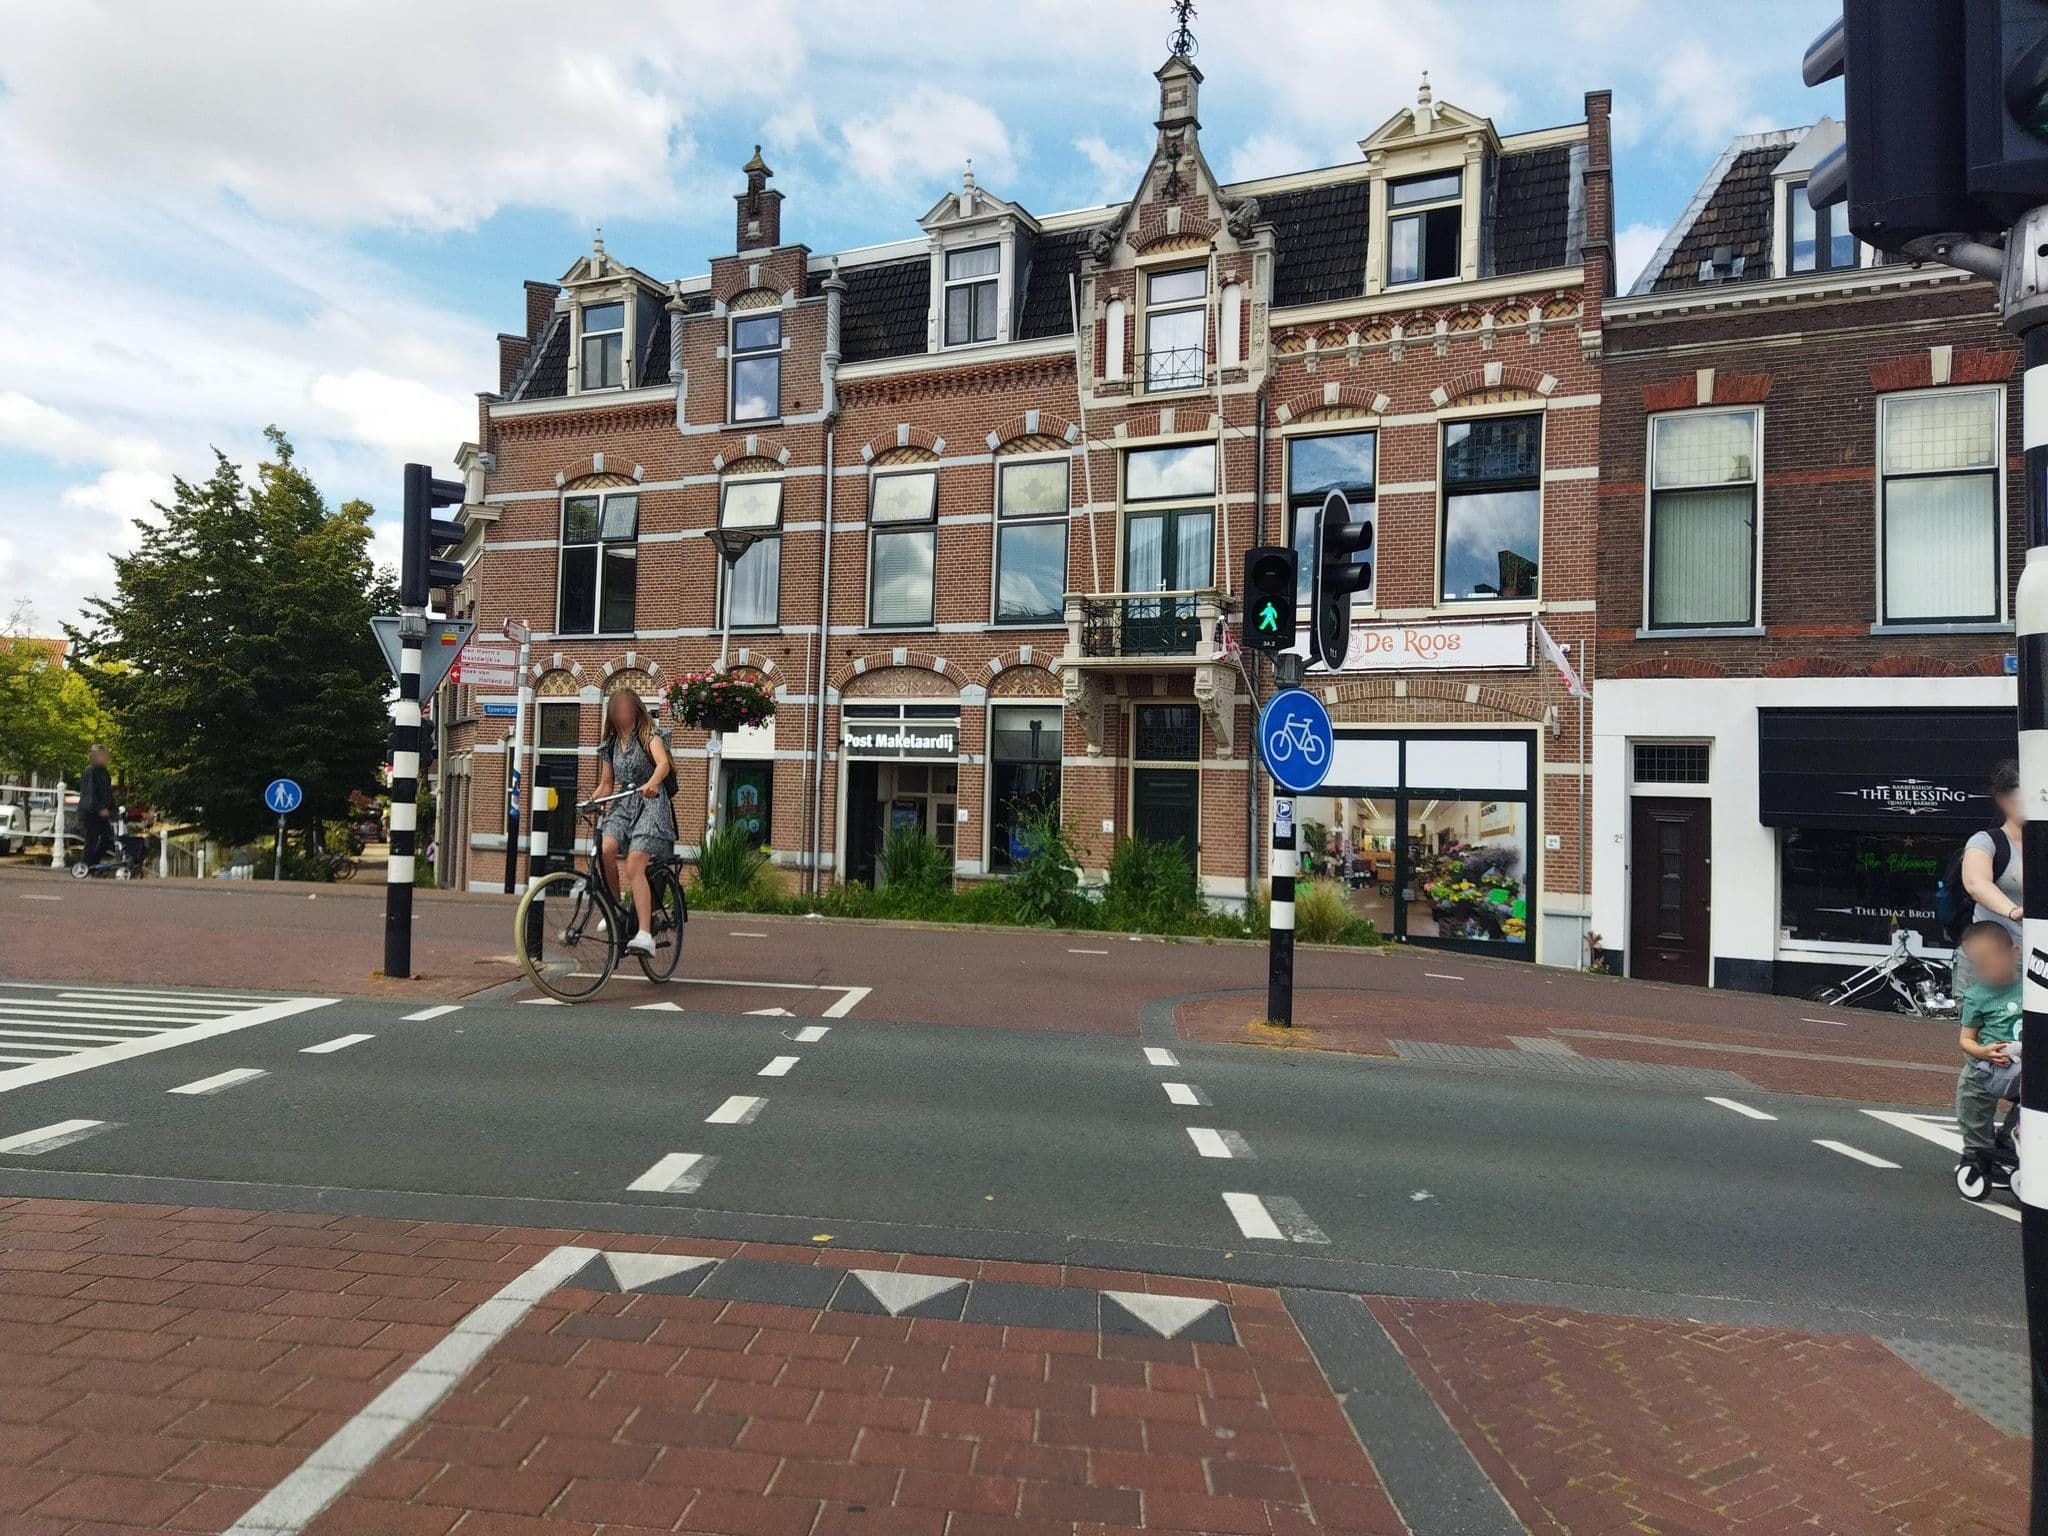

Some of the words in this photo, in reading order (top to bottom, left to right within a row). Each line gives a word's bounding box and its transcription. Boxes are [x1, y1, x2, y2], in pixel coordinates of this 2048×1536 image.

[1364, 632, 1393, 653] De
[1404, 629, 1461, 660] Roos
[844, 733, 873, 748] Post
[875, 733, 954, 753] Makelaardij
[1860, 788, 1891, 800] THE
[1895, 790, 1966, 802] BLESSING
[1880, 908, 1905, 918] DIAZ
[1908, 909, 1936, 919] BROT
